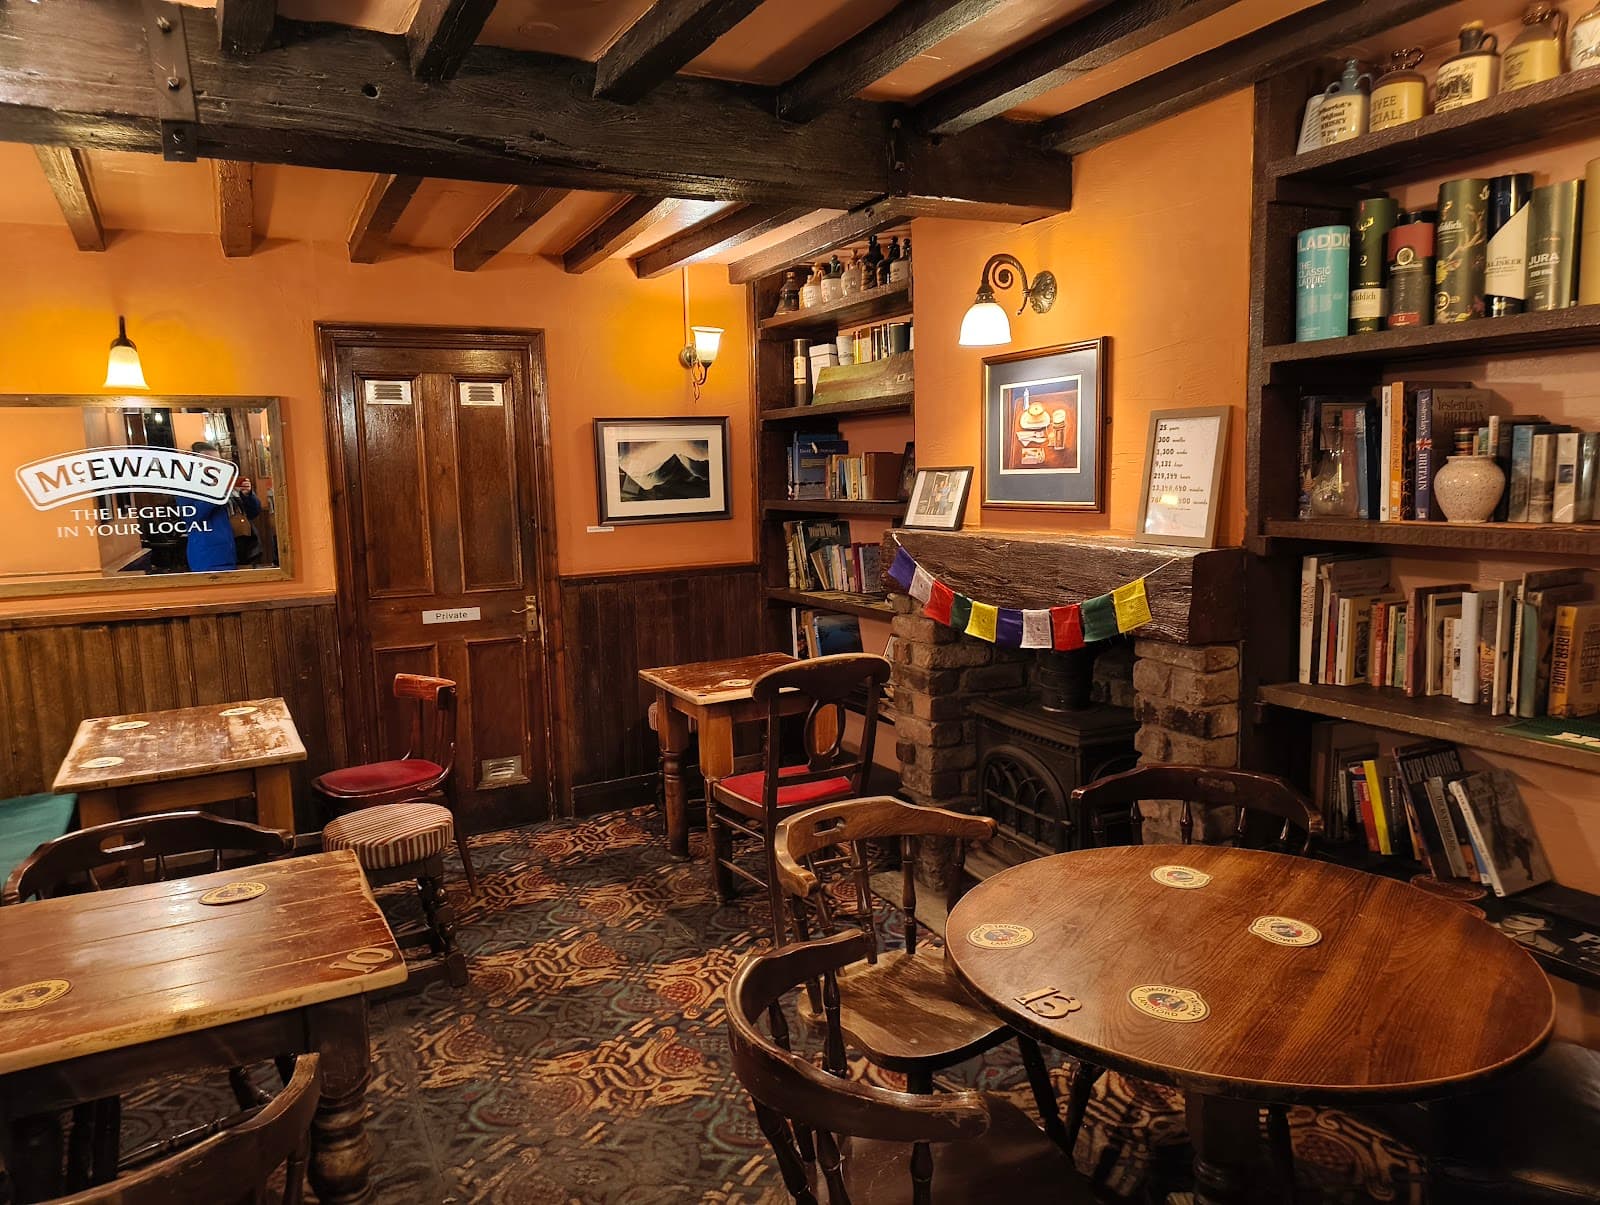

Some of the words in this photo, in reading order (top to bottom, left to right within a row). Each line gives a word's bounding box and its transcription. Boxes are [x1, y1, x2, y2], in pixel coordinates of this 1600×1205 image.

[1529, 252, 1559, 266] JURA
[1418, 453, 1428, 490] BRITAIN
[71, 508, 110, 521] THE
[117, 505, 197, 520] LEGEND
[57, 526, 79, 538] IN
[85, 524, 143, 537] YOUR
[149, 520, 213, 534] LOCAL
[435, 611, 468, 620] Private
[1402, 750, 1461, 784] EXPLORING
[328, 947, 394, 974] 10
